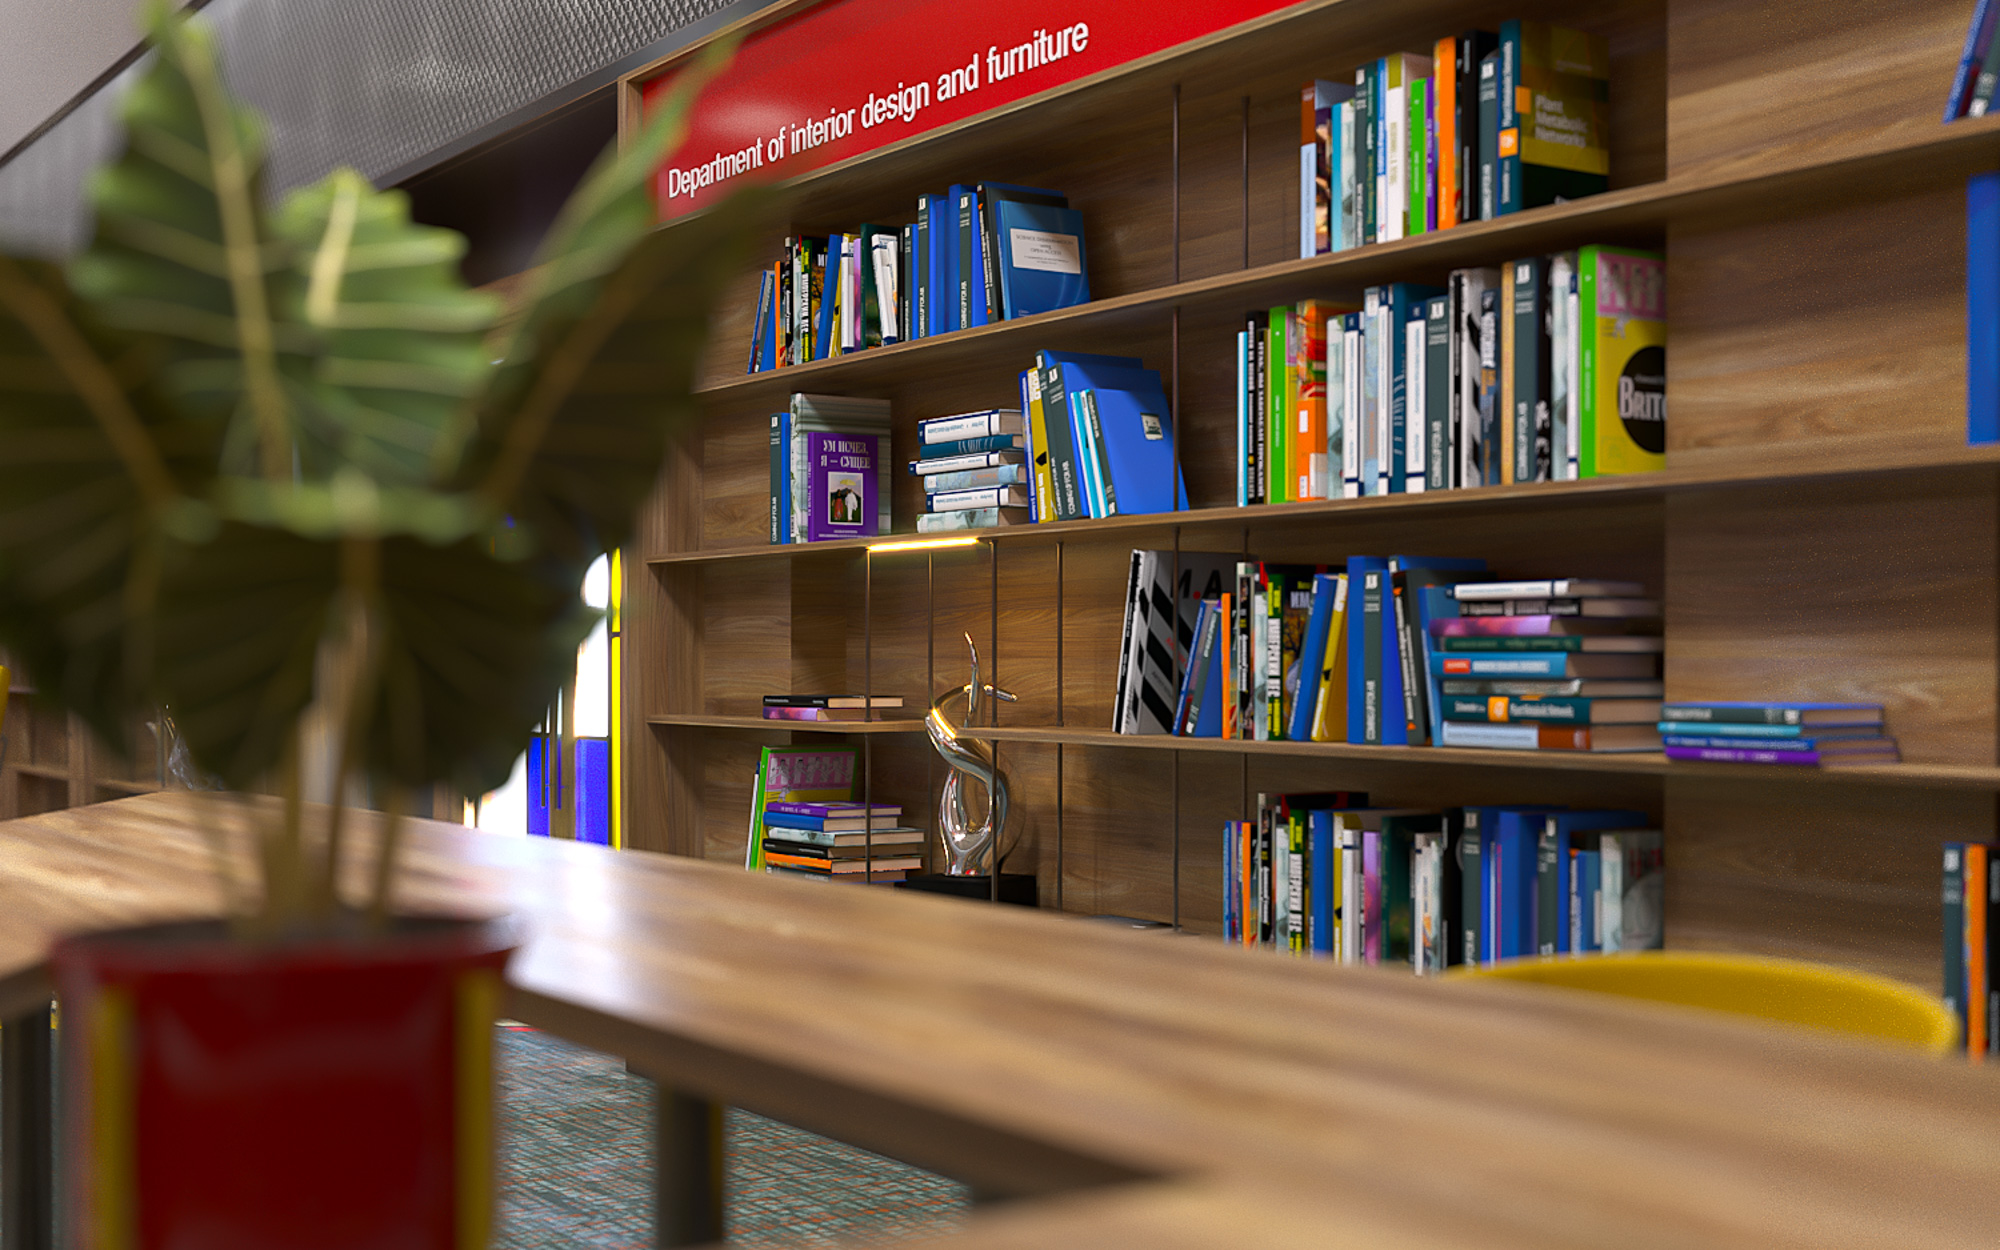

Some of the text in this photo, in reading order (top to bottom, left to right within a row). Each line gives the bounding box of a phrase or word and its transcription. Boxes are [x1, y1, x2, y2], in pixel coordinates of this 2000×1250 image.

[668, 22, 1089, 198] Department of interior design and furniture
[823, 440, 869, 454] УМ ИСЧЕЗ,
[821, 455, 828, 467] Я
[840, 456, 871, 470] СУЩЕЕ
